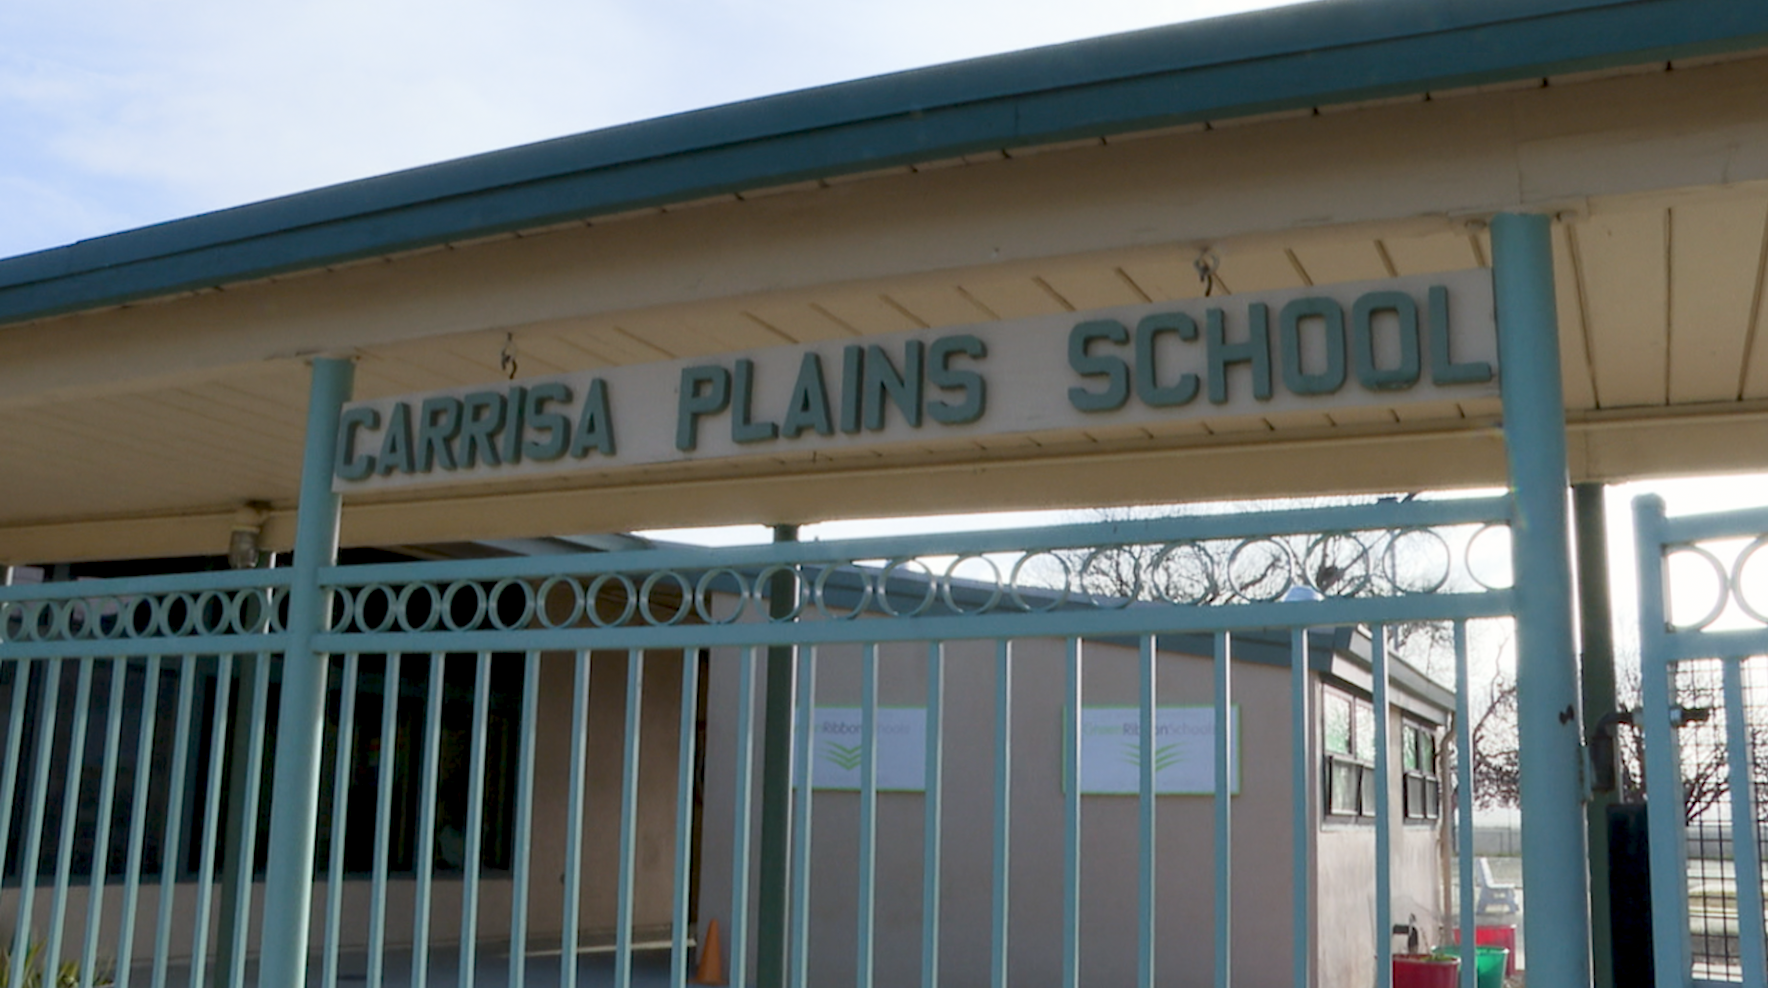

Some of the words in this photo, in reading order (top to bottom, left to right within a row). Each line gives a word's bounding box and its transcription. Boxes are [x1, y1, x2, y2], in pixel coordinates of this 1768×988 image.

[335, 377, 616, 481] CARRISA
[675, 333, 988, 453] PLAINS
[1067, 285, 1493, 413] SCHOOL
